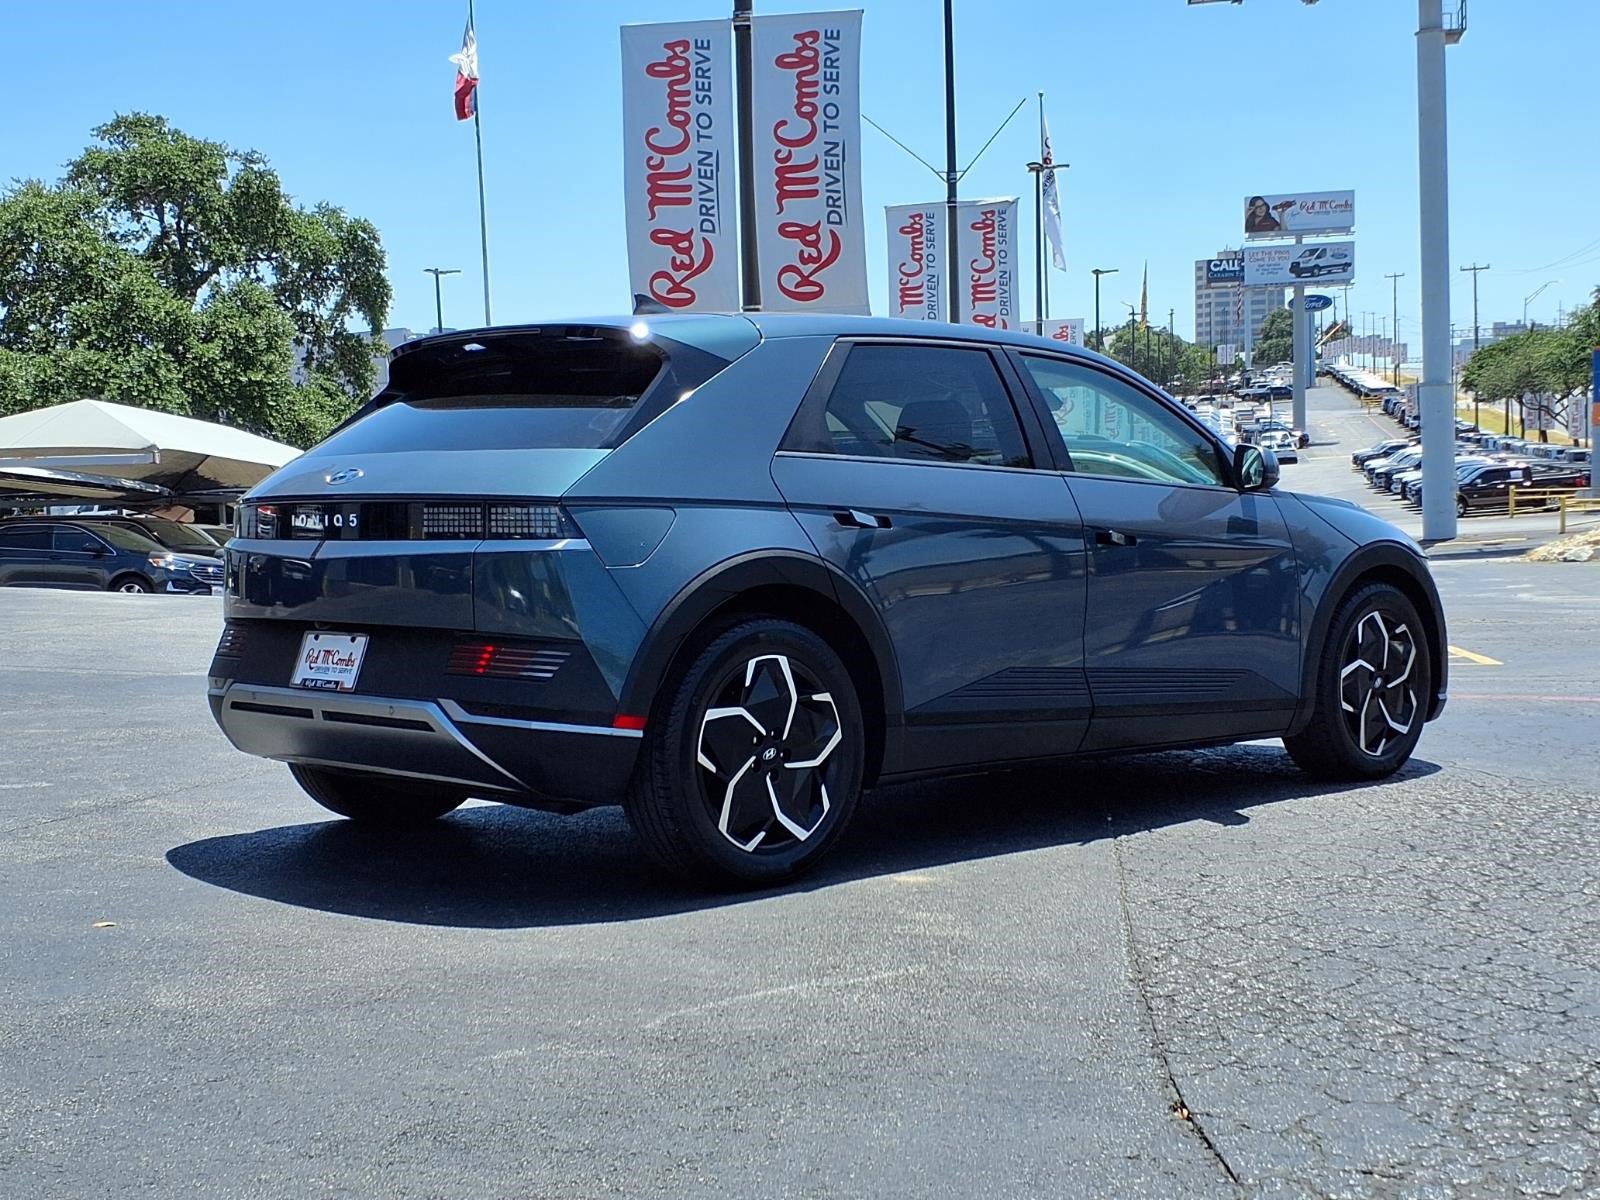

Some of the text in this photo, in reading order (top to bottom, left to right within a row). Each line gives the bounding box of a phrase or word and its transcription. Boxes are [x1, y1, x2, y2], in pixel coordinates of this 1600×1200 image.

[644, 38, 714, 308] Red McCombs
[694, 38, 717, 234] DRIVEN TO SERVE
[772, 29, 842, 302] Red McCombs
[822, 28, 843, 226] DRIVEN TO SERVE
[898, 212, 924, 314] McCombs
[925, 211, 937, 320] DRIVEN TO SERVE
[970, 209, 997, 311] McCombs
[997, 208, 1010, 316] DRIVEN TO SERVE
[1210, 259, 1240, 271] CALL
[291, 513, 358, 528] IONIQ 5
[305, 647, 356, 671] Red McCombs
